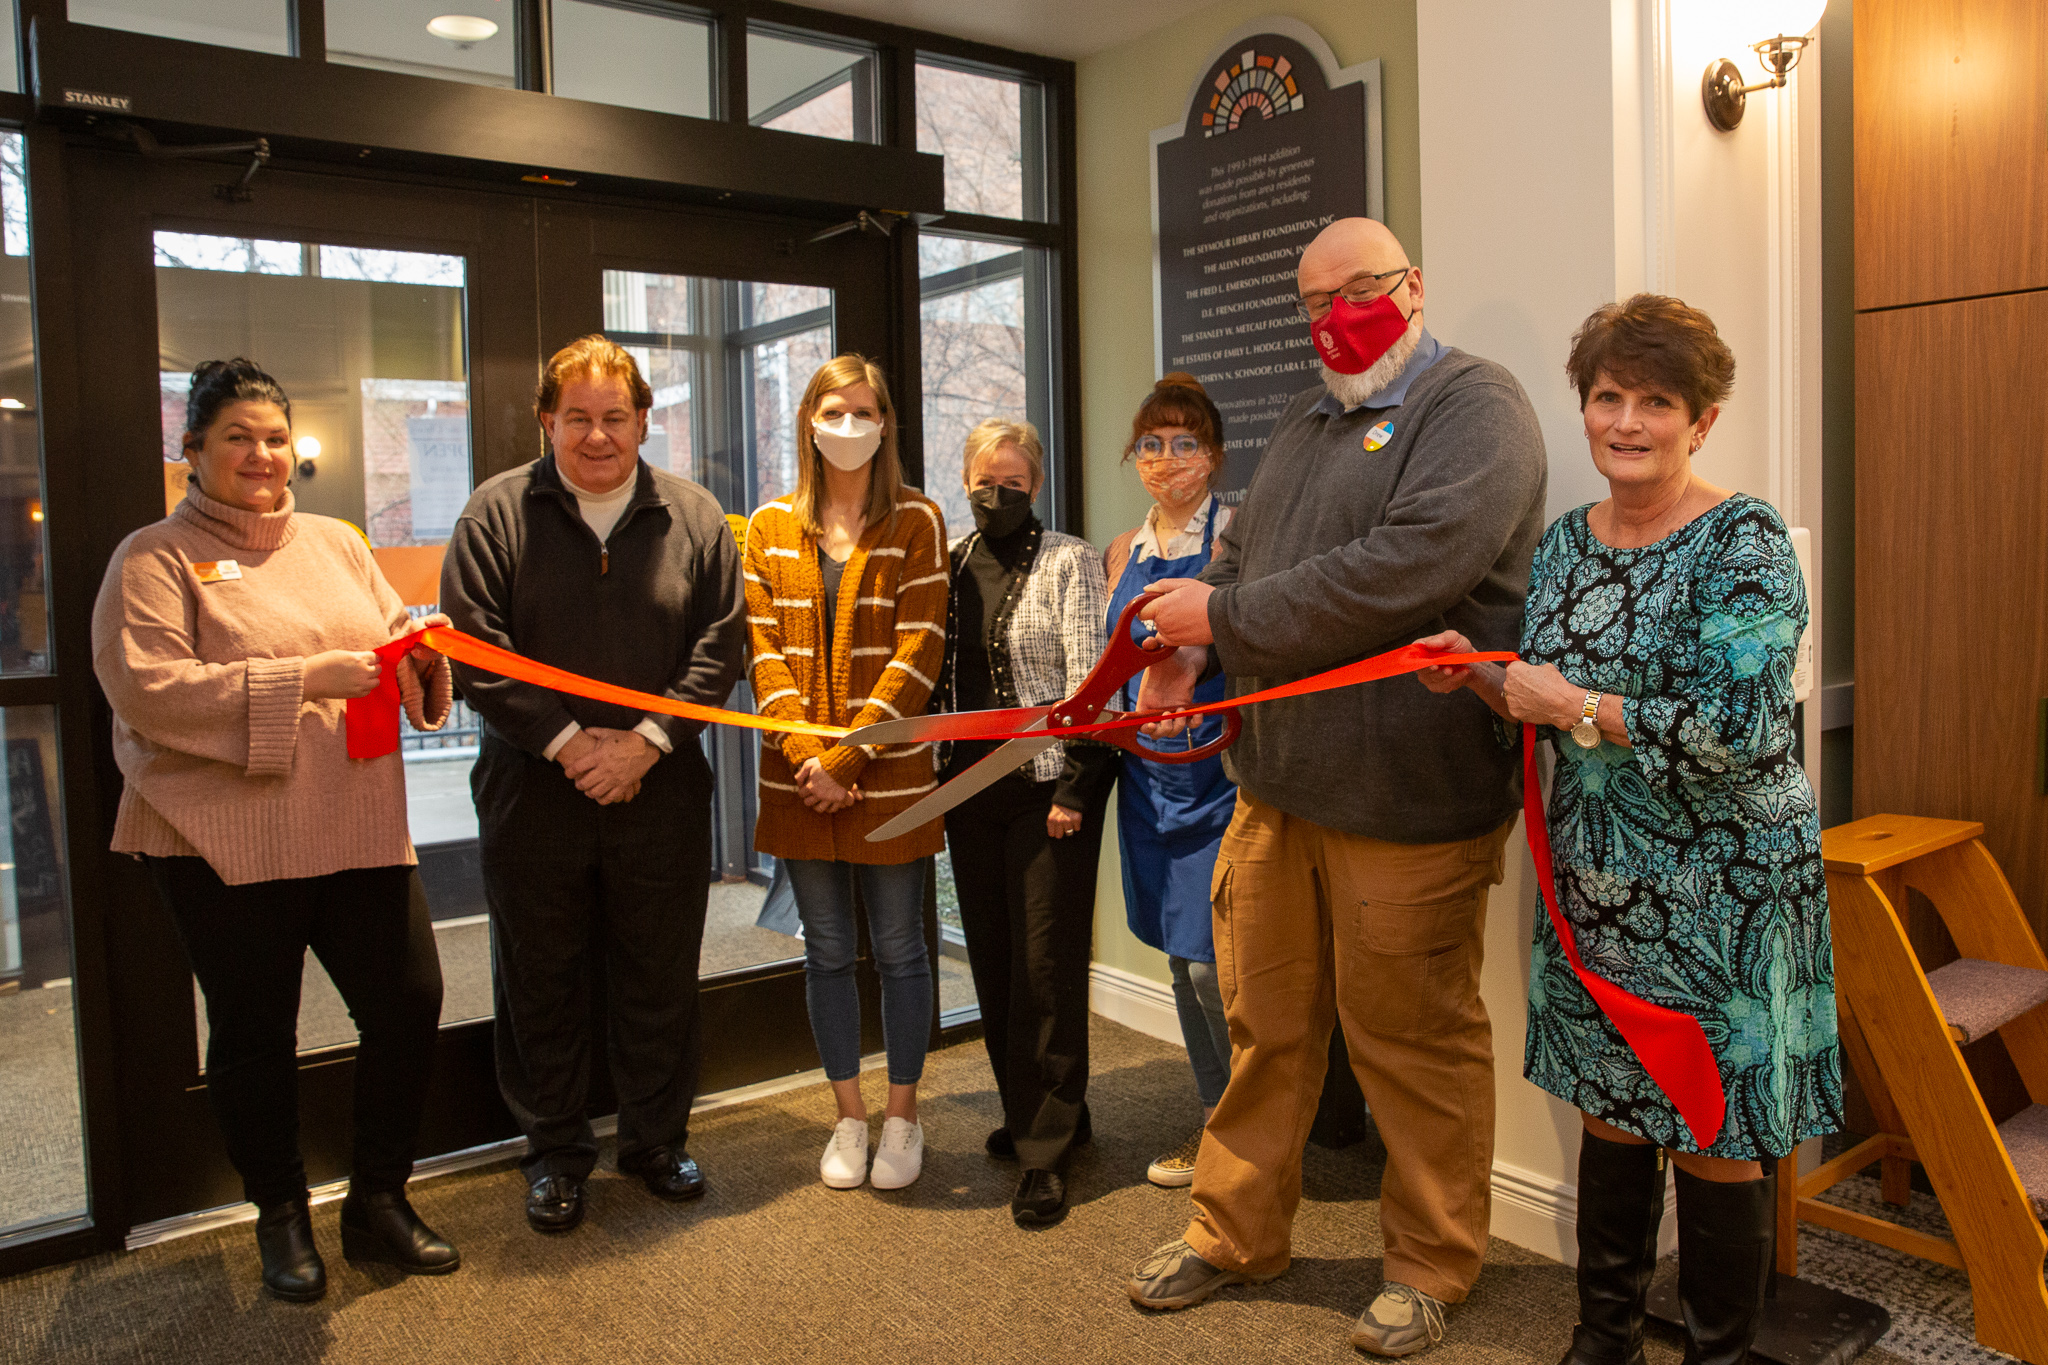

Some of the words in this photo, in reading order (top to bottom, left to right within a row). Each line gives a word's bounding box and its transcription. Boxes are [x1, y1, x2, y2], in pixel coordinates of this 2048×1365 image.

[65, 91, 129, 109] STANLEY
[1268, 146, 1300, 163] addition
[1213, 178, 1234, 192] made
[1235, 169, 1266, 188] possible
[1267, 166, 1278, 179] by
[1278, 158, 1315, 177] generous
[1202, 193, 1237, 210] donations
[1239, 186, 1257, 199] from
[1258, 184, 1275, 195] area
[1276, 174, 1311, 190] residents
[1203, 211, 1218, 224] and
[1183, 247, 1196, 258] THE
[1197, 238, 1231, 255] SEYMOUR
[1232, 231, 1261, 246] LIBRARY
[1262, 218, 1318, 241] FOUNDATION,
[1204, 263, 1217, 275] THE
[1218, 257, 1240, 271] ALLYN
[1241, 247, 1295, 267] FOUNDATION,
[1186, 289, 1199, 300] THE
[1200, 285, 1217, 298] FRED
[1218, 283, 1225, 293] L.
[1226, 276, 1260, 292] EMERSON
[1261, 268, 1298, 284] FOUNDAT
[1216, 301, 1244, 316] FRENCH
[1182, 333, 1194, 343] THE
[1195, 328, 1224, 341] STANLEY
[1225, 326, 1234, 336] W.
[1236, 321, 1267, 334] METCALF
[1268, 314, 1307, 328] FOUNDA
[1173, 356, 1185, 366] THE
[1186, 351, 1211, 364] ESTATES
[1212, 349, 1223, 360] OF
[1224, 346, 1245, 358] EMILY
[1246, 344, 1253, 355] L.
[1253, 340, 1284, 355] HODGE,
[1285, 336, 1314, 348] FRANC
[1197, 370, 1224, 384] ATHRYN
[1225, 370, 1234, 380] N.
[1235, 363, 1273, 379] SCHNOOP,
[1274, 361, 1299, 374] CLARA
[1300, 359, 1308, 369] E.
[1257, 397, 1266, 406] in
[1267, 393, 1288, 405] 2022
[1228, 412, 1249, 424] made
[1222, 439, 1243, 452] STATE
[1244, 439, 1254, 448] OF
[1255, 438, 1270, 449] JEA
